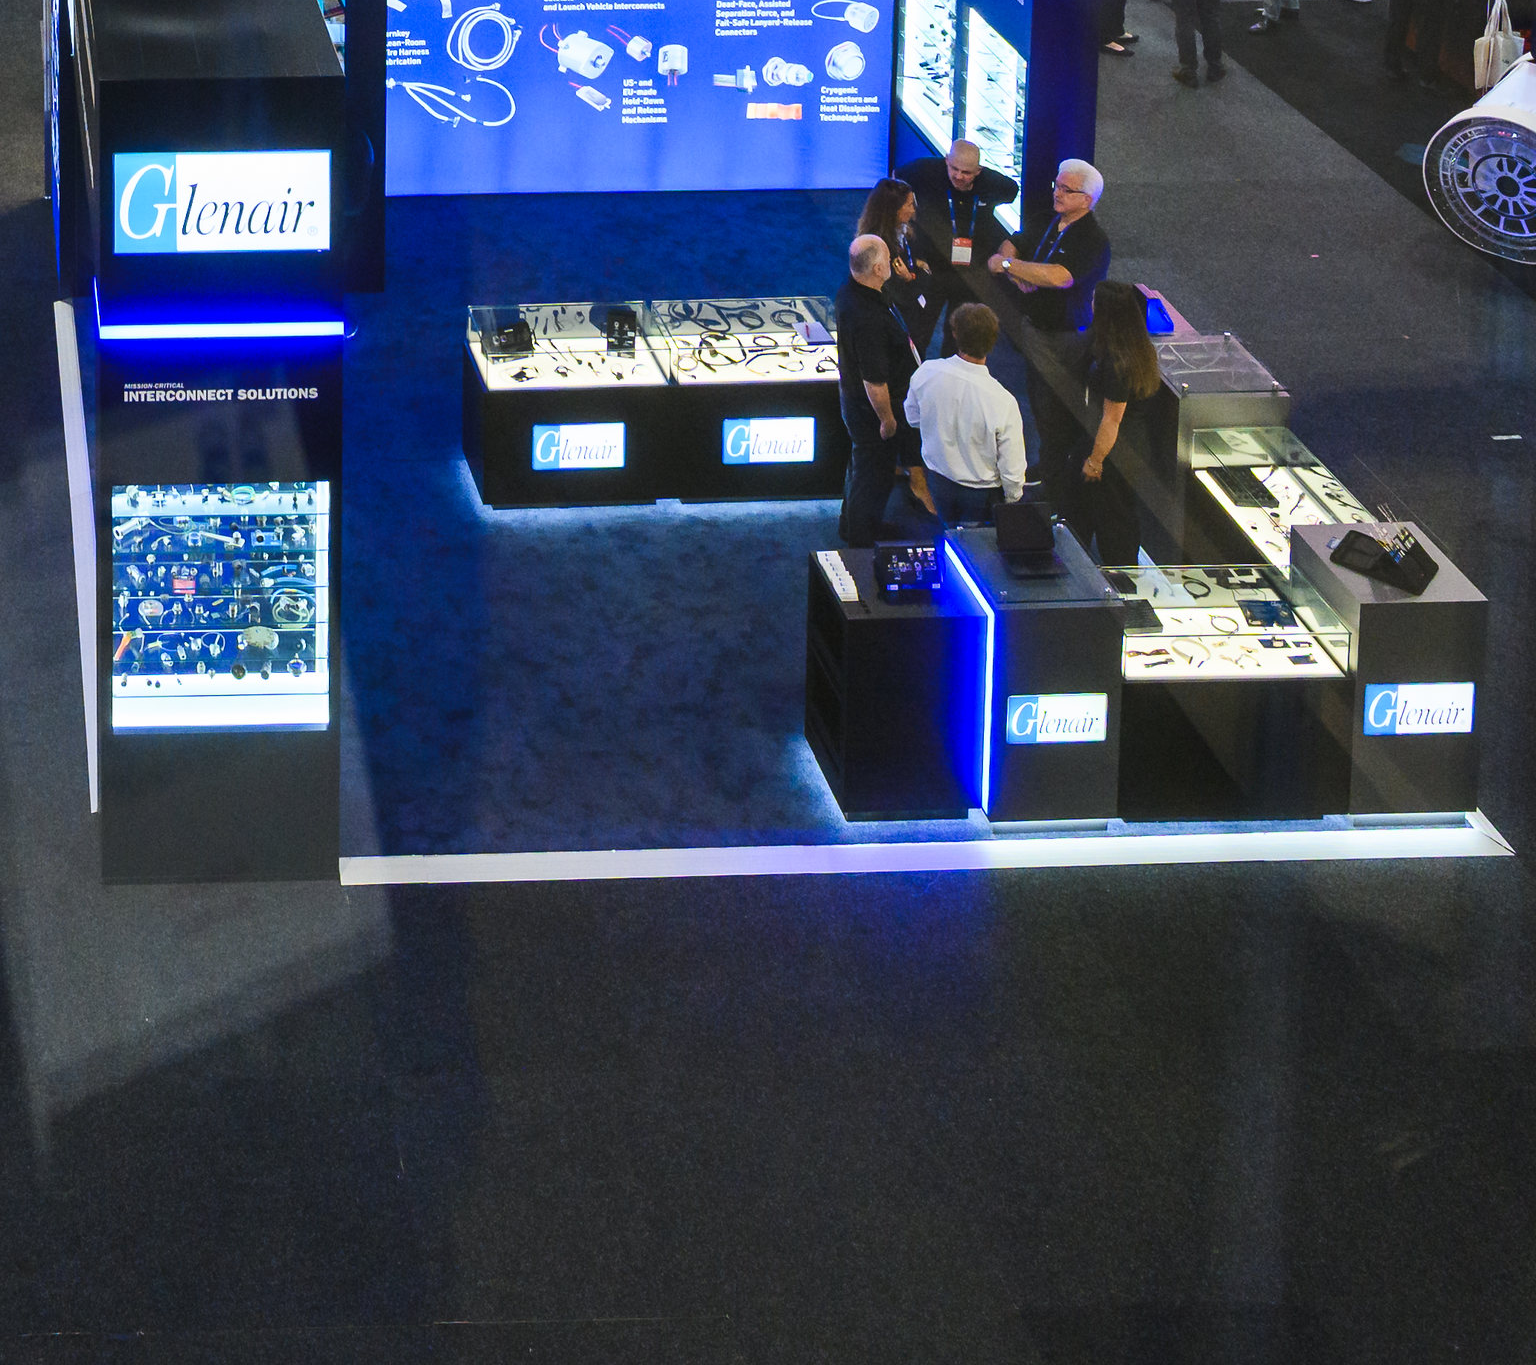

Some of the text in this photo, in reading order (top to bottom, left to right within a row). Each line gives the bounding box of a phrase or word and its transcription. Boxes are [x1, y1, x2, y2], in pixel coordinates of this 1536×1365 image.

[558, 3, 584, 11] Launch
[586, 2, 613, 10] Vehicle
[614, 2, 665, 10] Interconnects
[716, 0, 791, 9] Dead-Face, Assisted
[715, 18, 813, 27] Fail-Safe Lanyard-Release
[715, 28, 757, 37] Connectors
[623, 88, 657, 97] EU-made
[821, 86, 858, 96] Cryogenic
[622, 97, 664, 106] Hold-Down
[820, 104, 880, 114] Heat Dissipation
[621, 115, 667, 124] Mechanisms
[820, 114, 868, 123] Technologies
[119, 163, 316, 241] Glenair
[123, 387, 318, 402] INTERCONNECT SOLUTIONS
[534, 425, 618, 464] Glenair
[724, 422, 809, 459] Glenair
[1367, 687, 1466, 730] Glenair
[1010, 698, 1100, 739] Glenair
